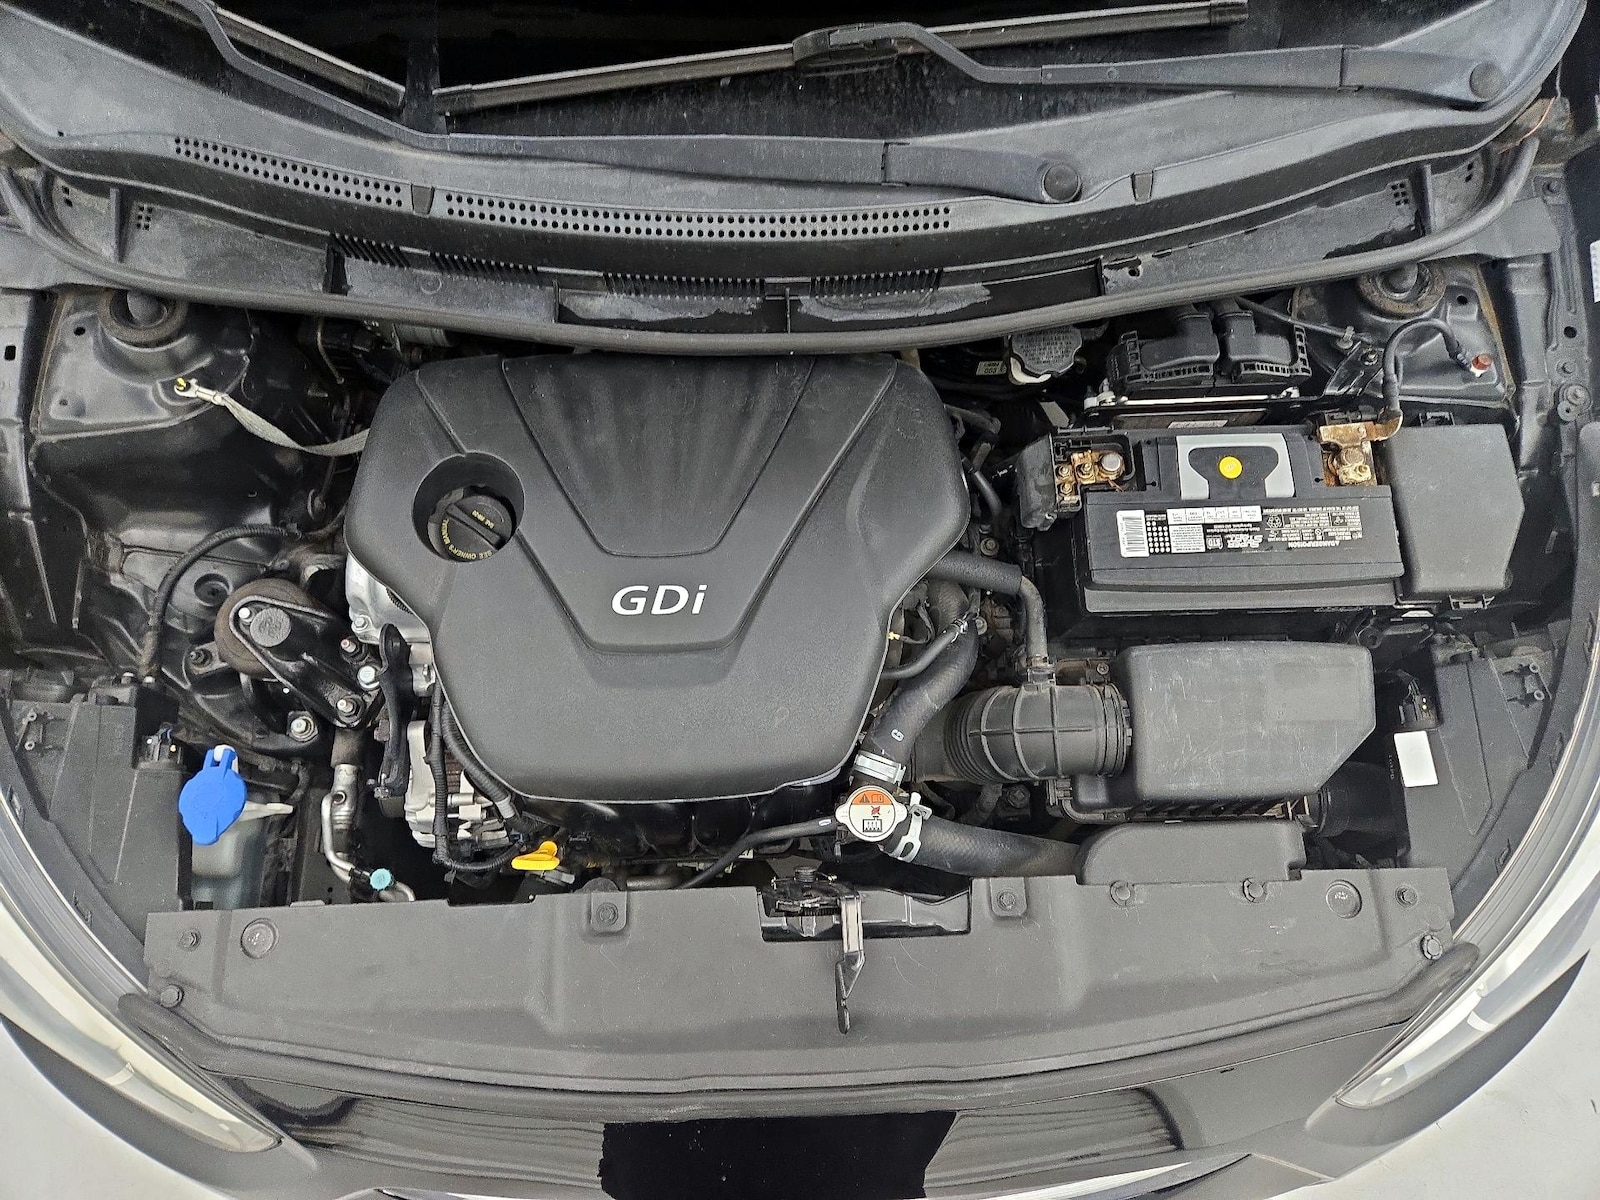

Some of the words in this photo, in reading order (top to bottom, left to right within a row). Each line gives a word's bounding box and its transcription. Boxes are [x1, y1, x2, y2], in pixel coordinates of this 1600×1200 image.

[441, 518, 451, 545] MANUAL
[448, 544, 477, 560] OWNER'S
[1227, 540, 1260, 548] SUPER
[479, 550, 492, 559] SEE
[611, 584, 708, 615] GDi
